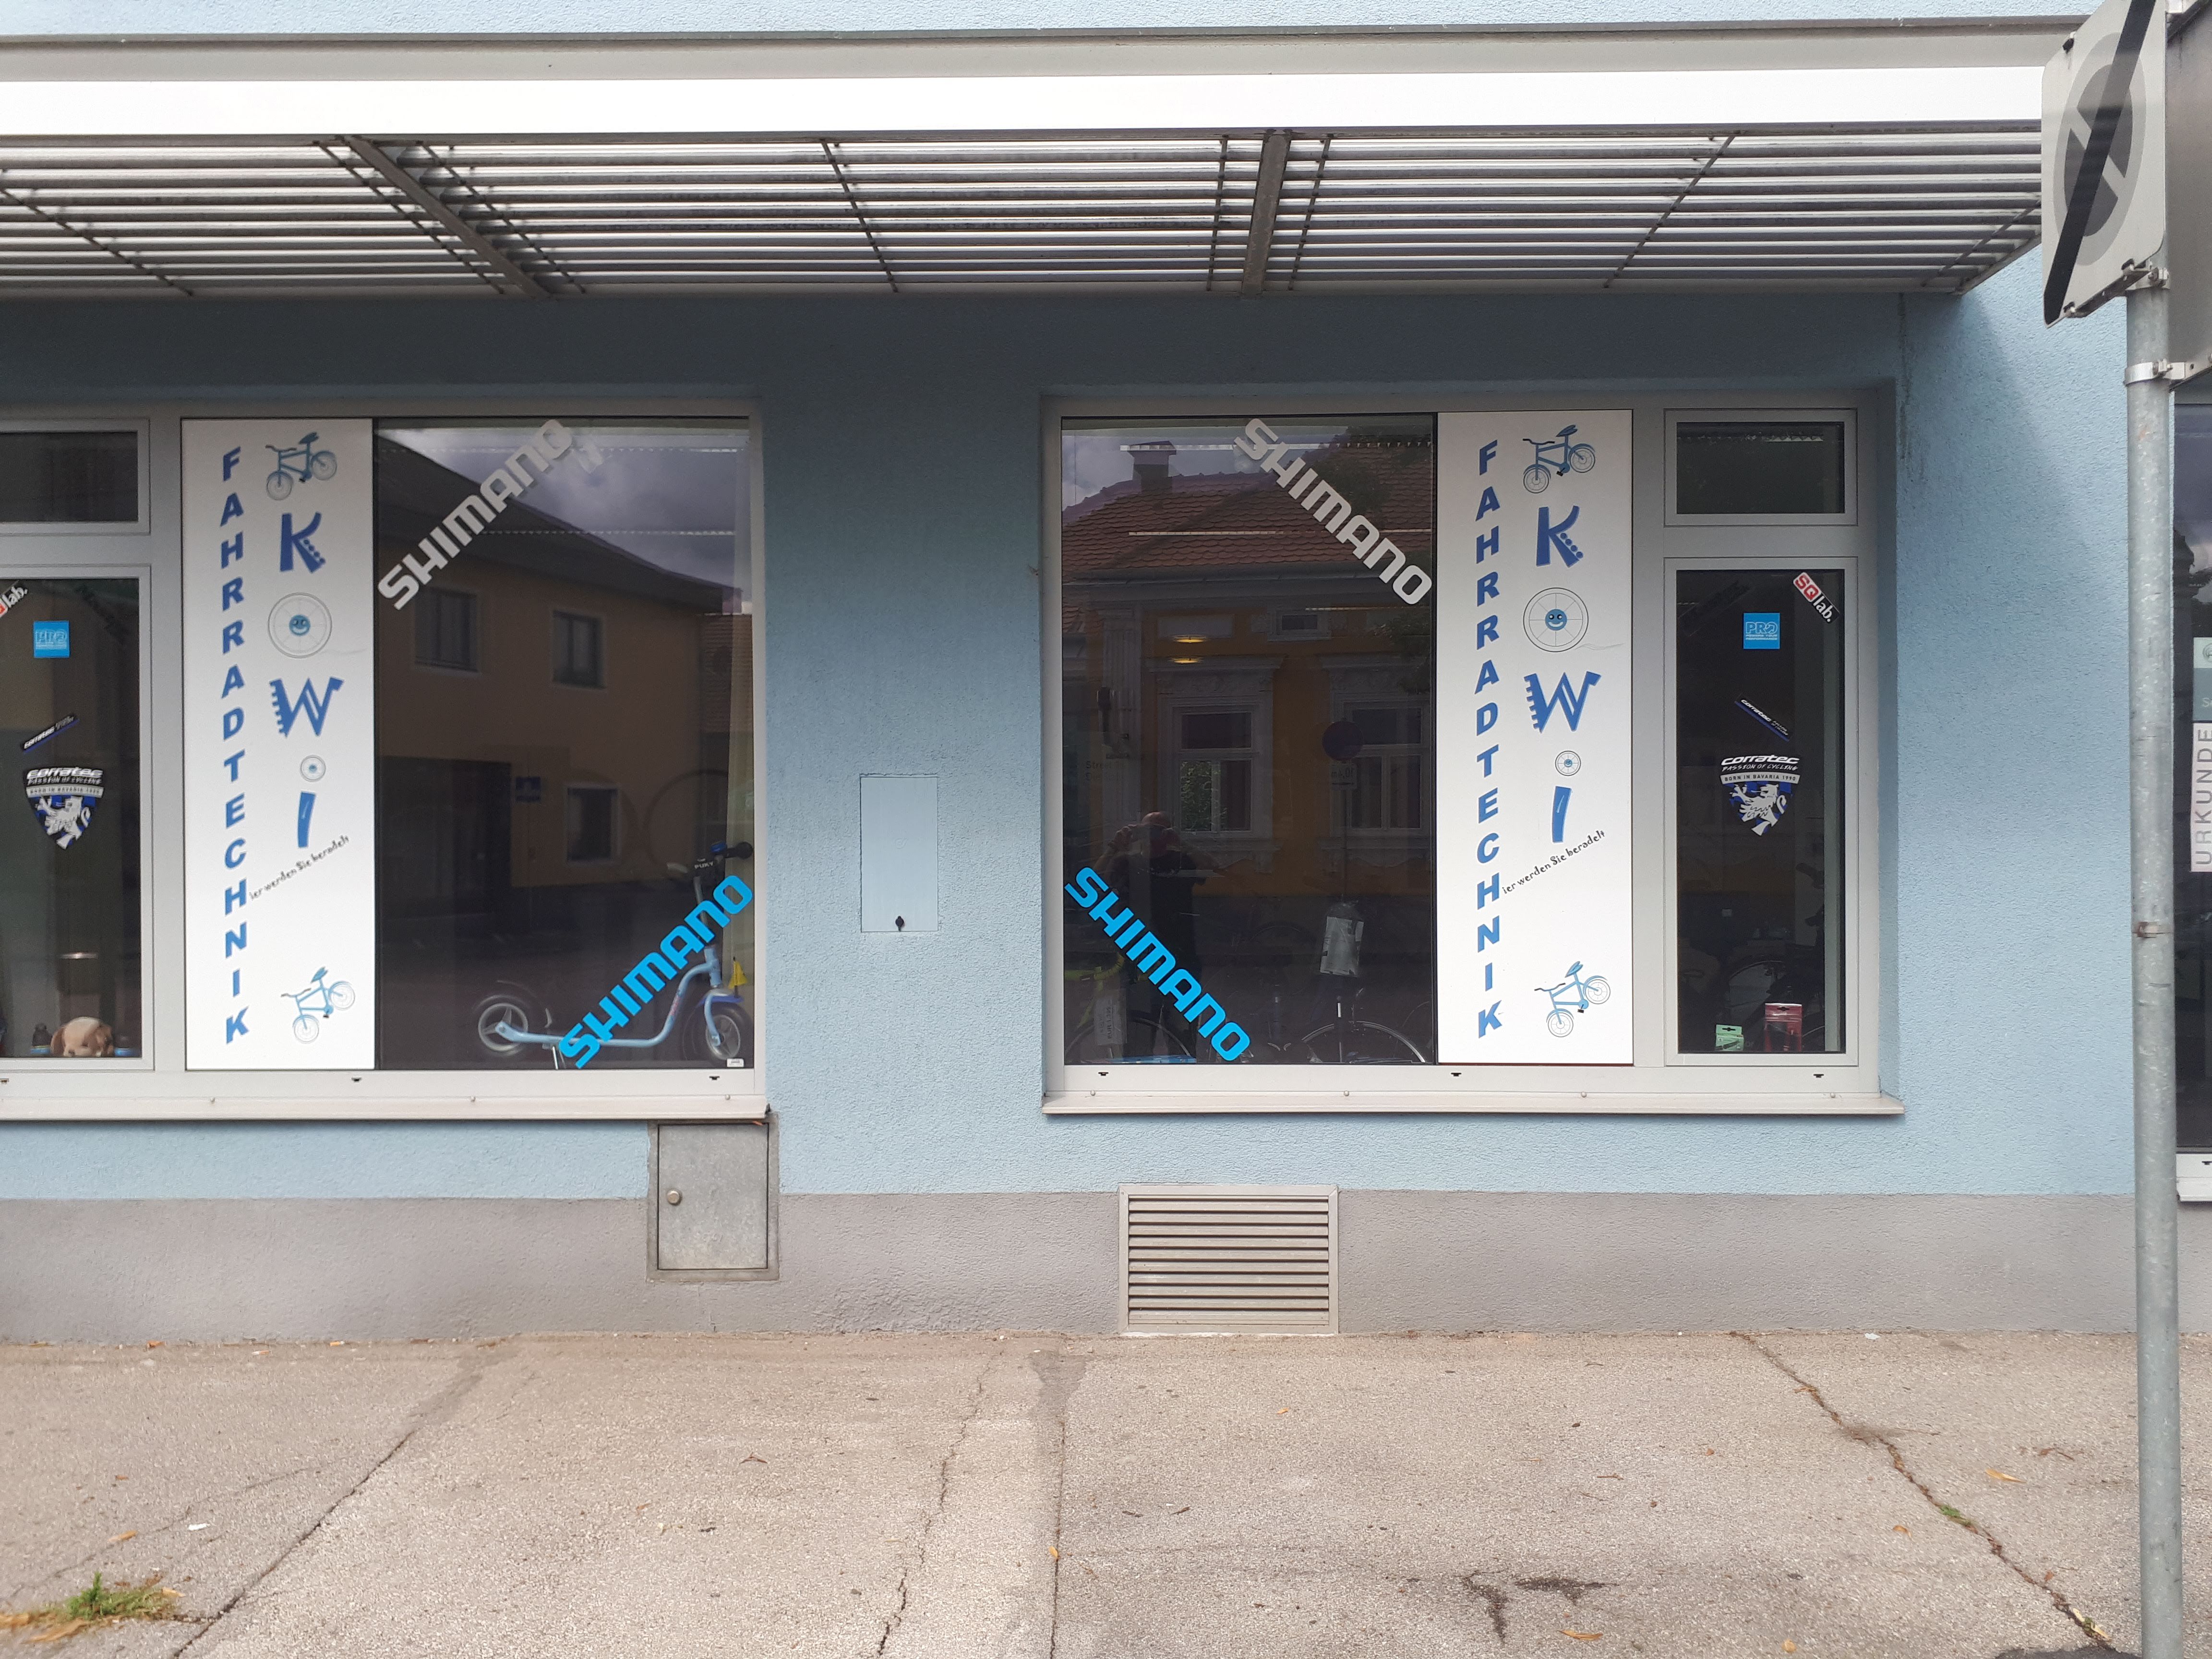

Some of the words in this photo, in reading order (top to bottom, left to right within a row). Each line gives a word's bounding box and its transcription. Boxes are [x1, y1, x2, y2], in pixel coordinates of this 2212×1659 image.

[378, 419, 574, 610] SHIMANO
[1234, 419, 1432, 605] SHIMANO
[0, 586, 28, 613] lab.
[1745, 621, 1778, 634] PRO
[220, 446, 249, 1044] FAHRRADTECHNIK
[1475, 439, 1503, 1038] FAHRRADTECHNIK
[1741, 699, 1771, 721] corratec
[26, 767, 104, 779] corratec
[1721, 754, 1800, 766] corratec
[2194, 729, 2212, 865] URKUNDE
[694, 861, 714, 869] PUKY
[1517, 864, 1551, 886] werden
[1550, 854, 1566, 866] Sie
[1565, 830, 1605, 857] beradelt
[559, 875, 753, 1069] SHIMANO
[1065, 867, 1251, 1061] SHIMANO
